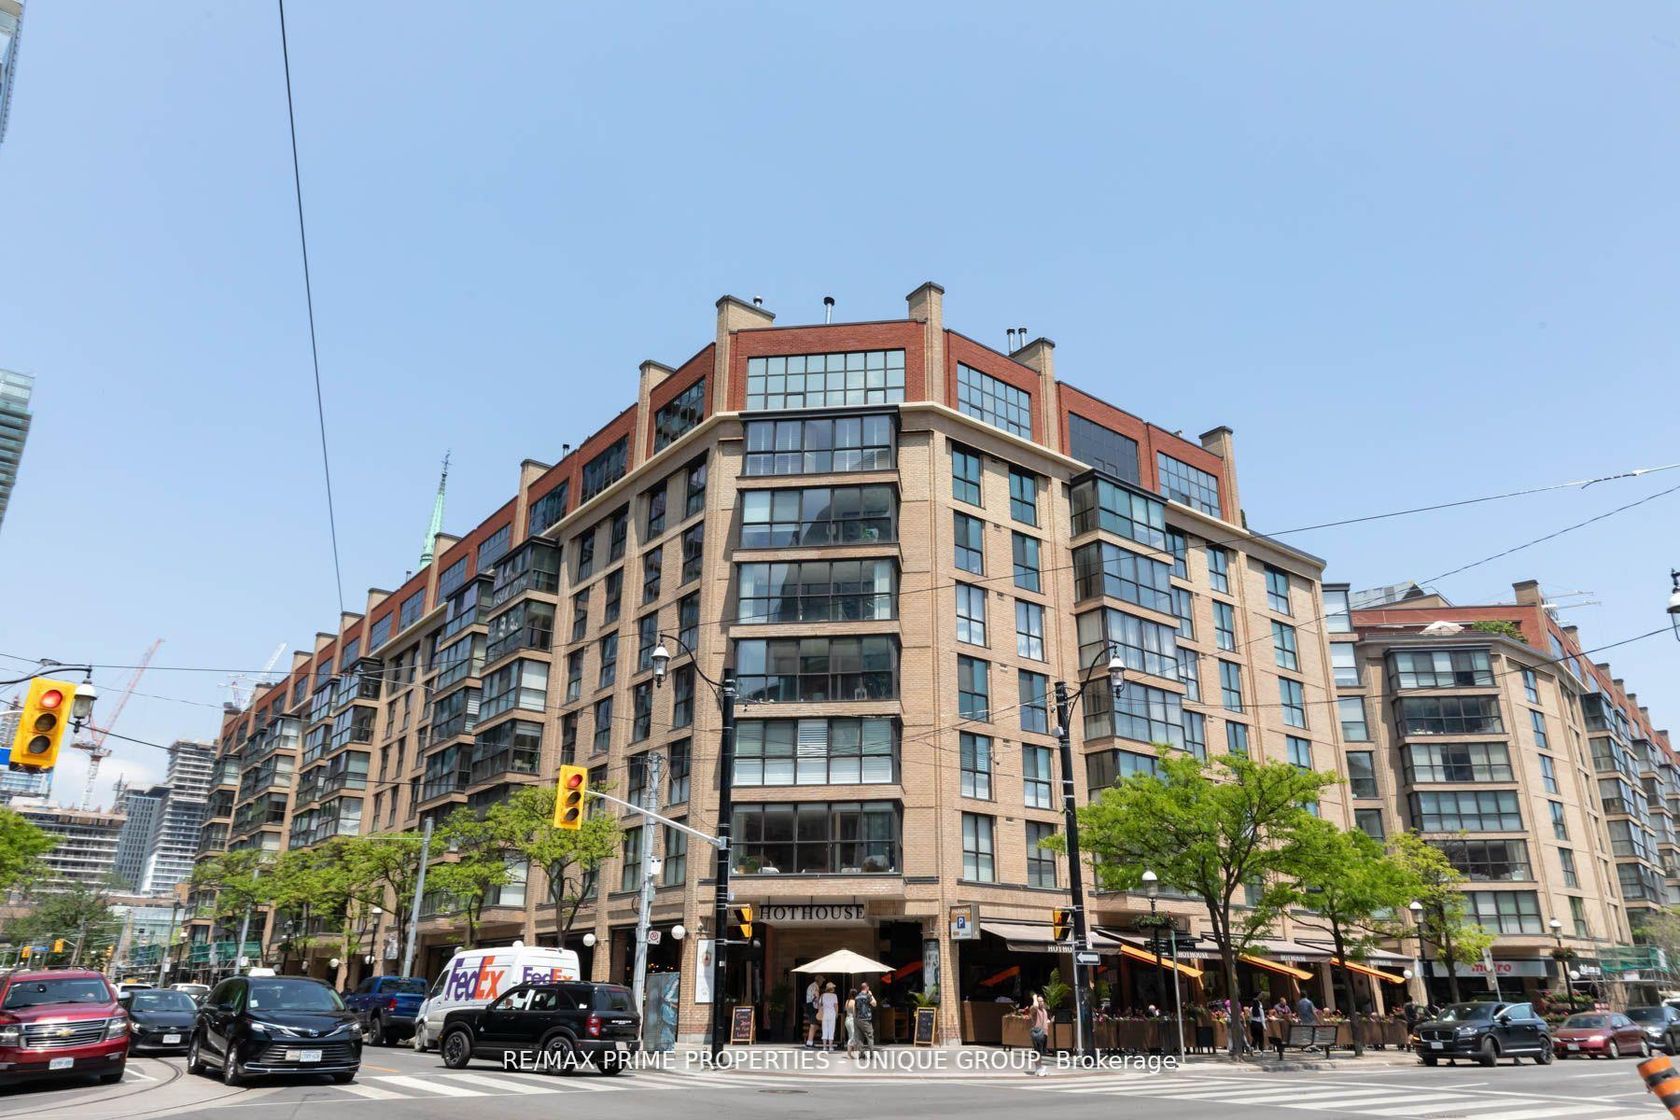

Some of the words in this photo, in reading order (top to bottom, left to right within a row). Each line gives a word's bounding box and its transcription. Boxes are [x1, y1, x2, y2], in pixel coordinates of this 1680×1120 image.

[759, 906, 865, 920] HOTHOUSE
[1048, 945, 1073, 953] HOTHO
[1472, 963, 1511, 973] mro
[444, 955, 505, 1001] FedEx
